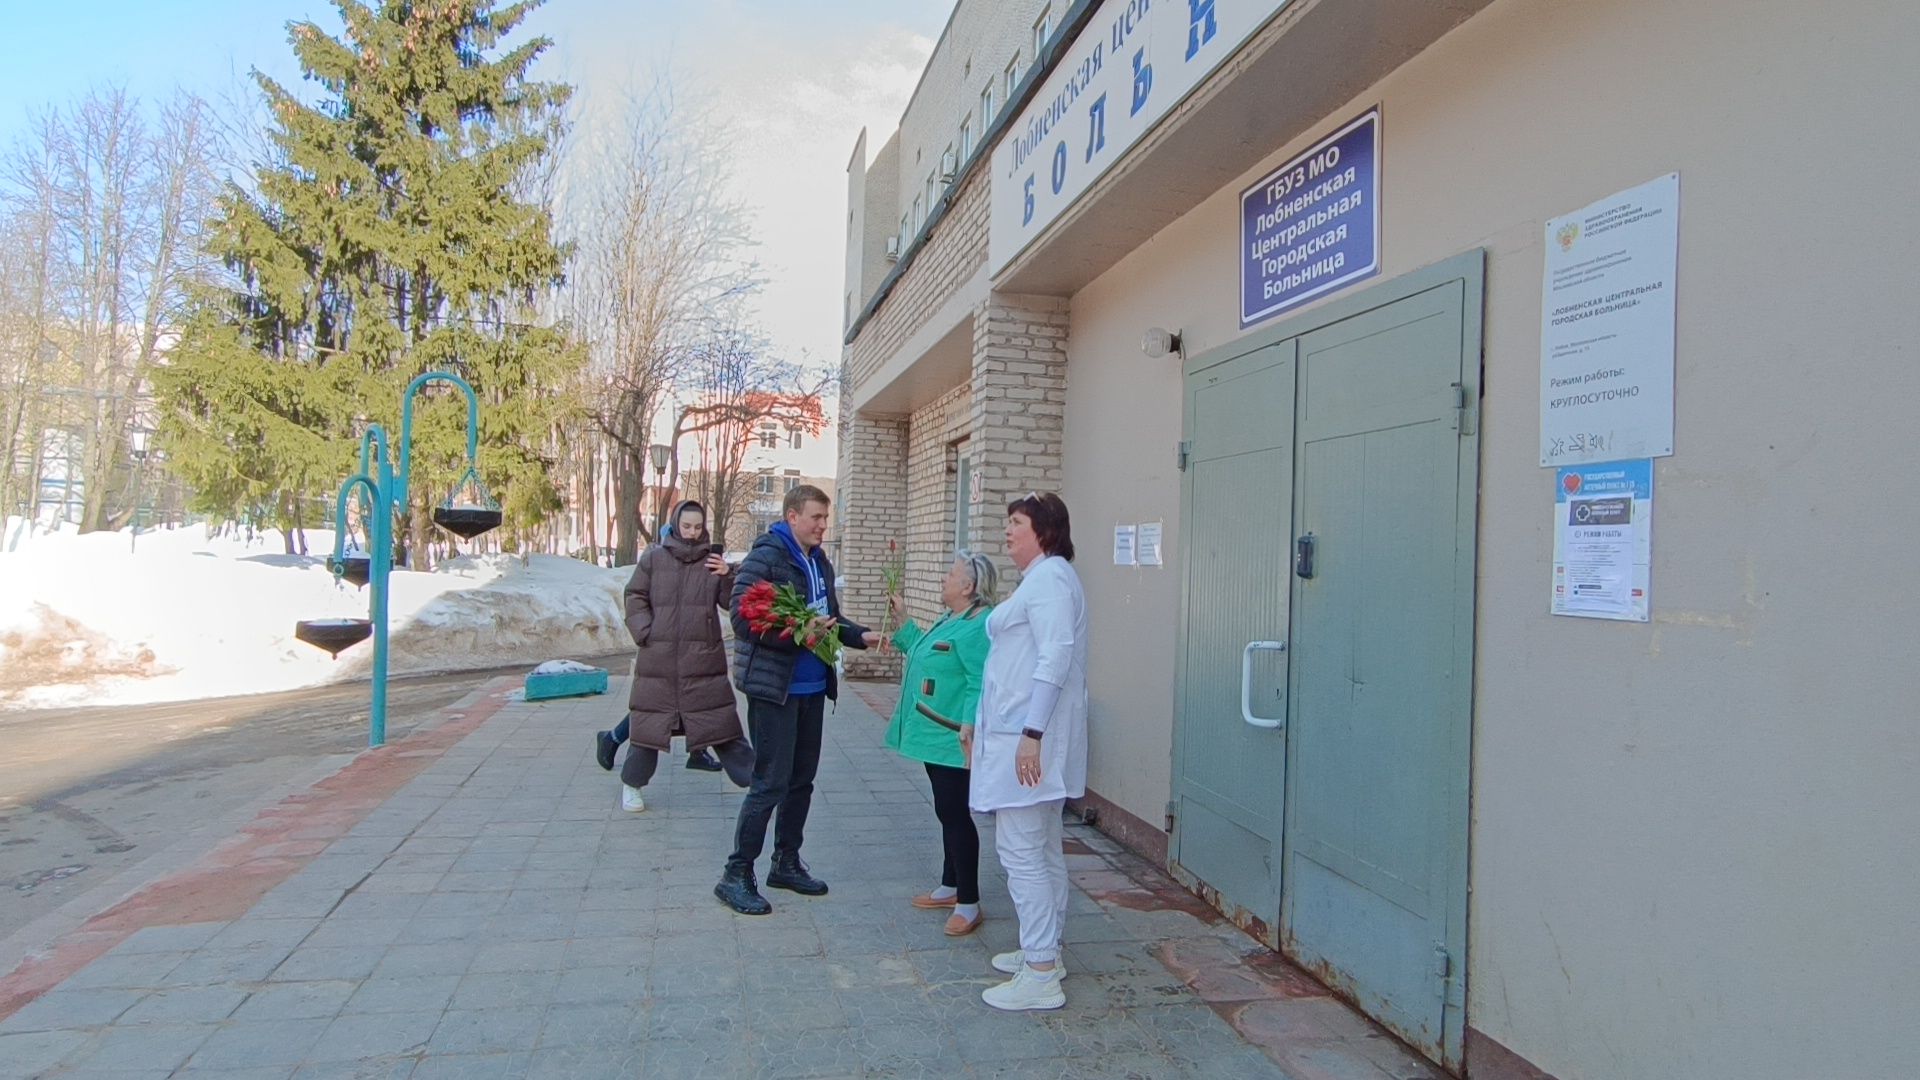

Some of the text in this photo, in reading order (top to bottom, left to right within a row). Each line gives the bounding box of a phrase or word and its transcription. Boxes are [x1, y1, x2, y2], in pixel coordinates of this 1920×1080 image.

[1008, 40, 1104, 180] Лобненская
[1255, 166, 1356, 236] Лобненская
[1266, 145, 1340, 206] ГБУЗ МО
[1251, 189, 1362, 261] Центральная
[1261, 223, 1348, 278] Городская
[1263, 251, 1345, 300] Больница
[1605, 281, 1663, 303] ЦЕНТРАЛЬНАЯ
[1551, 310, 1594, 327] ГОРОДСКАЯ
[1550, 367, 1625, 388] Режим работы:
[1550, 385, 1640, 409] КРУГЛОСУТОЧНО
